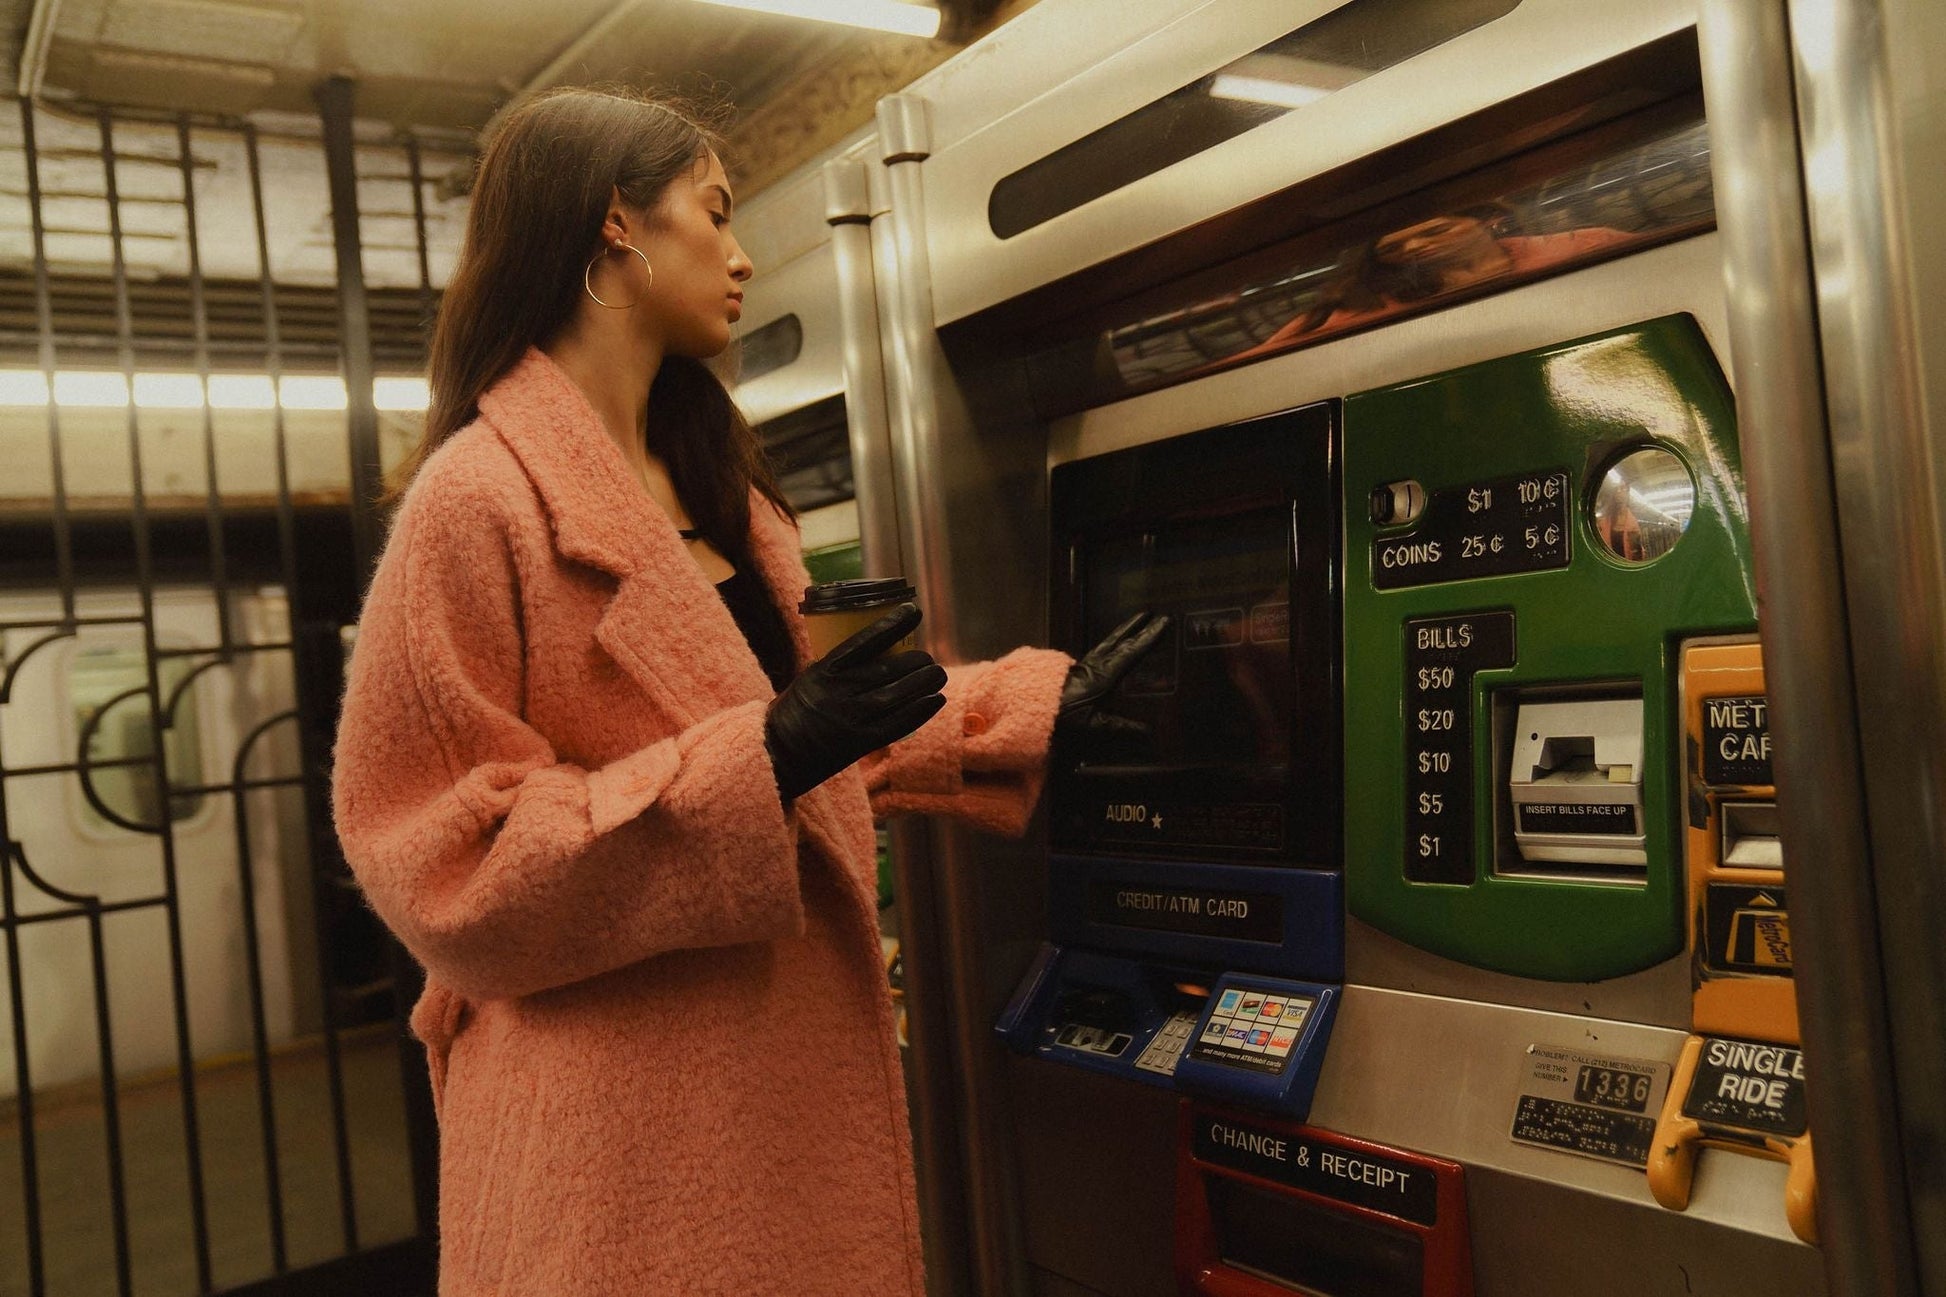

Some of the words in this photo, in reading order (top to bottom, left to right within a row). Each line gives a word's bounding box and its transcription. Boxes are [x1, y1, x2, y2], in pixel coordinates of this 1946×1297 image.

[1468, 488, 1492, 513] $1
[1382, 540, 1442, 569] COINS
[1418, 624, 1473, 650] BILLS
[1418, 666, 1454, 691] $50
[1418, 708, 1454, 733] $20
[1419, 750, 1451, 774] $10
[1106, 804, 1147, 823] AUDIO
[1419, 791, 1443, 815] $5
[1526, 805, 1557, 815] INSERT
[1559, 805, 1585, 815] BILLS
[1586, 806, 1612, 815] FACE
[1613, 806, 1627, 815] UP
[1419, 833, 1441, 858] $1
[1117, 891, 1200, 914] CREDIT/ATM
[1206, 898, 1248, 919] CARD
[1535, 1062, 1552, 1071] GIVE
[1552, 1064, 1568, 1074] THIS
[1571, 1055, 1591, 1065] CALL
[1608, 1061, 1657, 1074] METROCARD
[1708, 1042, 1805, 1080] SINGLE
[1533, 1071, 1562, 1082] NUMBER
[1581, 1068, 1649, 1101] 1336
[1718, 1073, 1789, 1108] RIDE
[1211, 1123, 1287, 1162] CHANGE
[1297, 1145, 1310, 1168] &
[1321, 1152, 1410, 1194] RECEIPT
